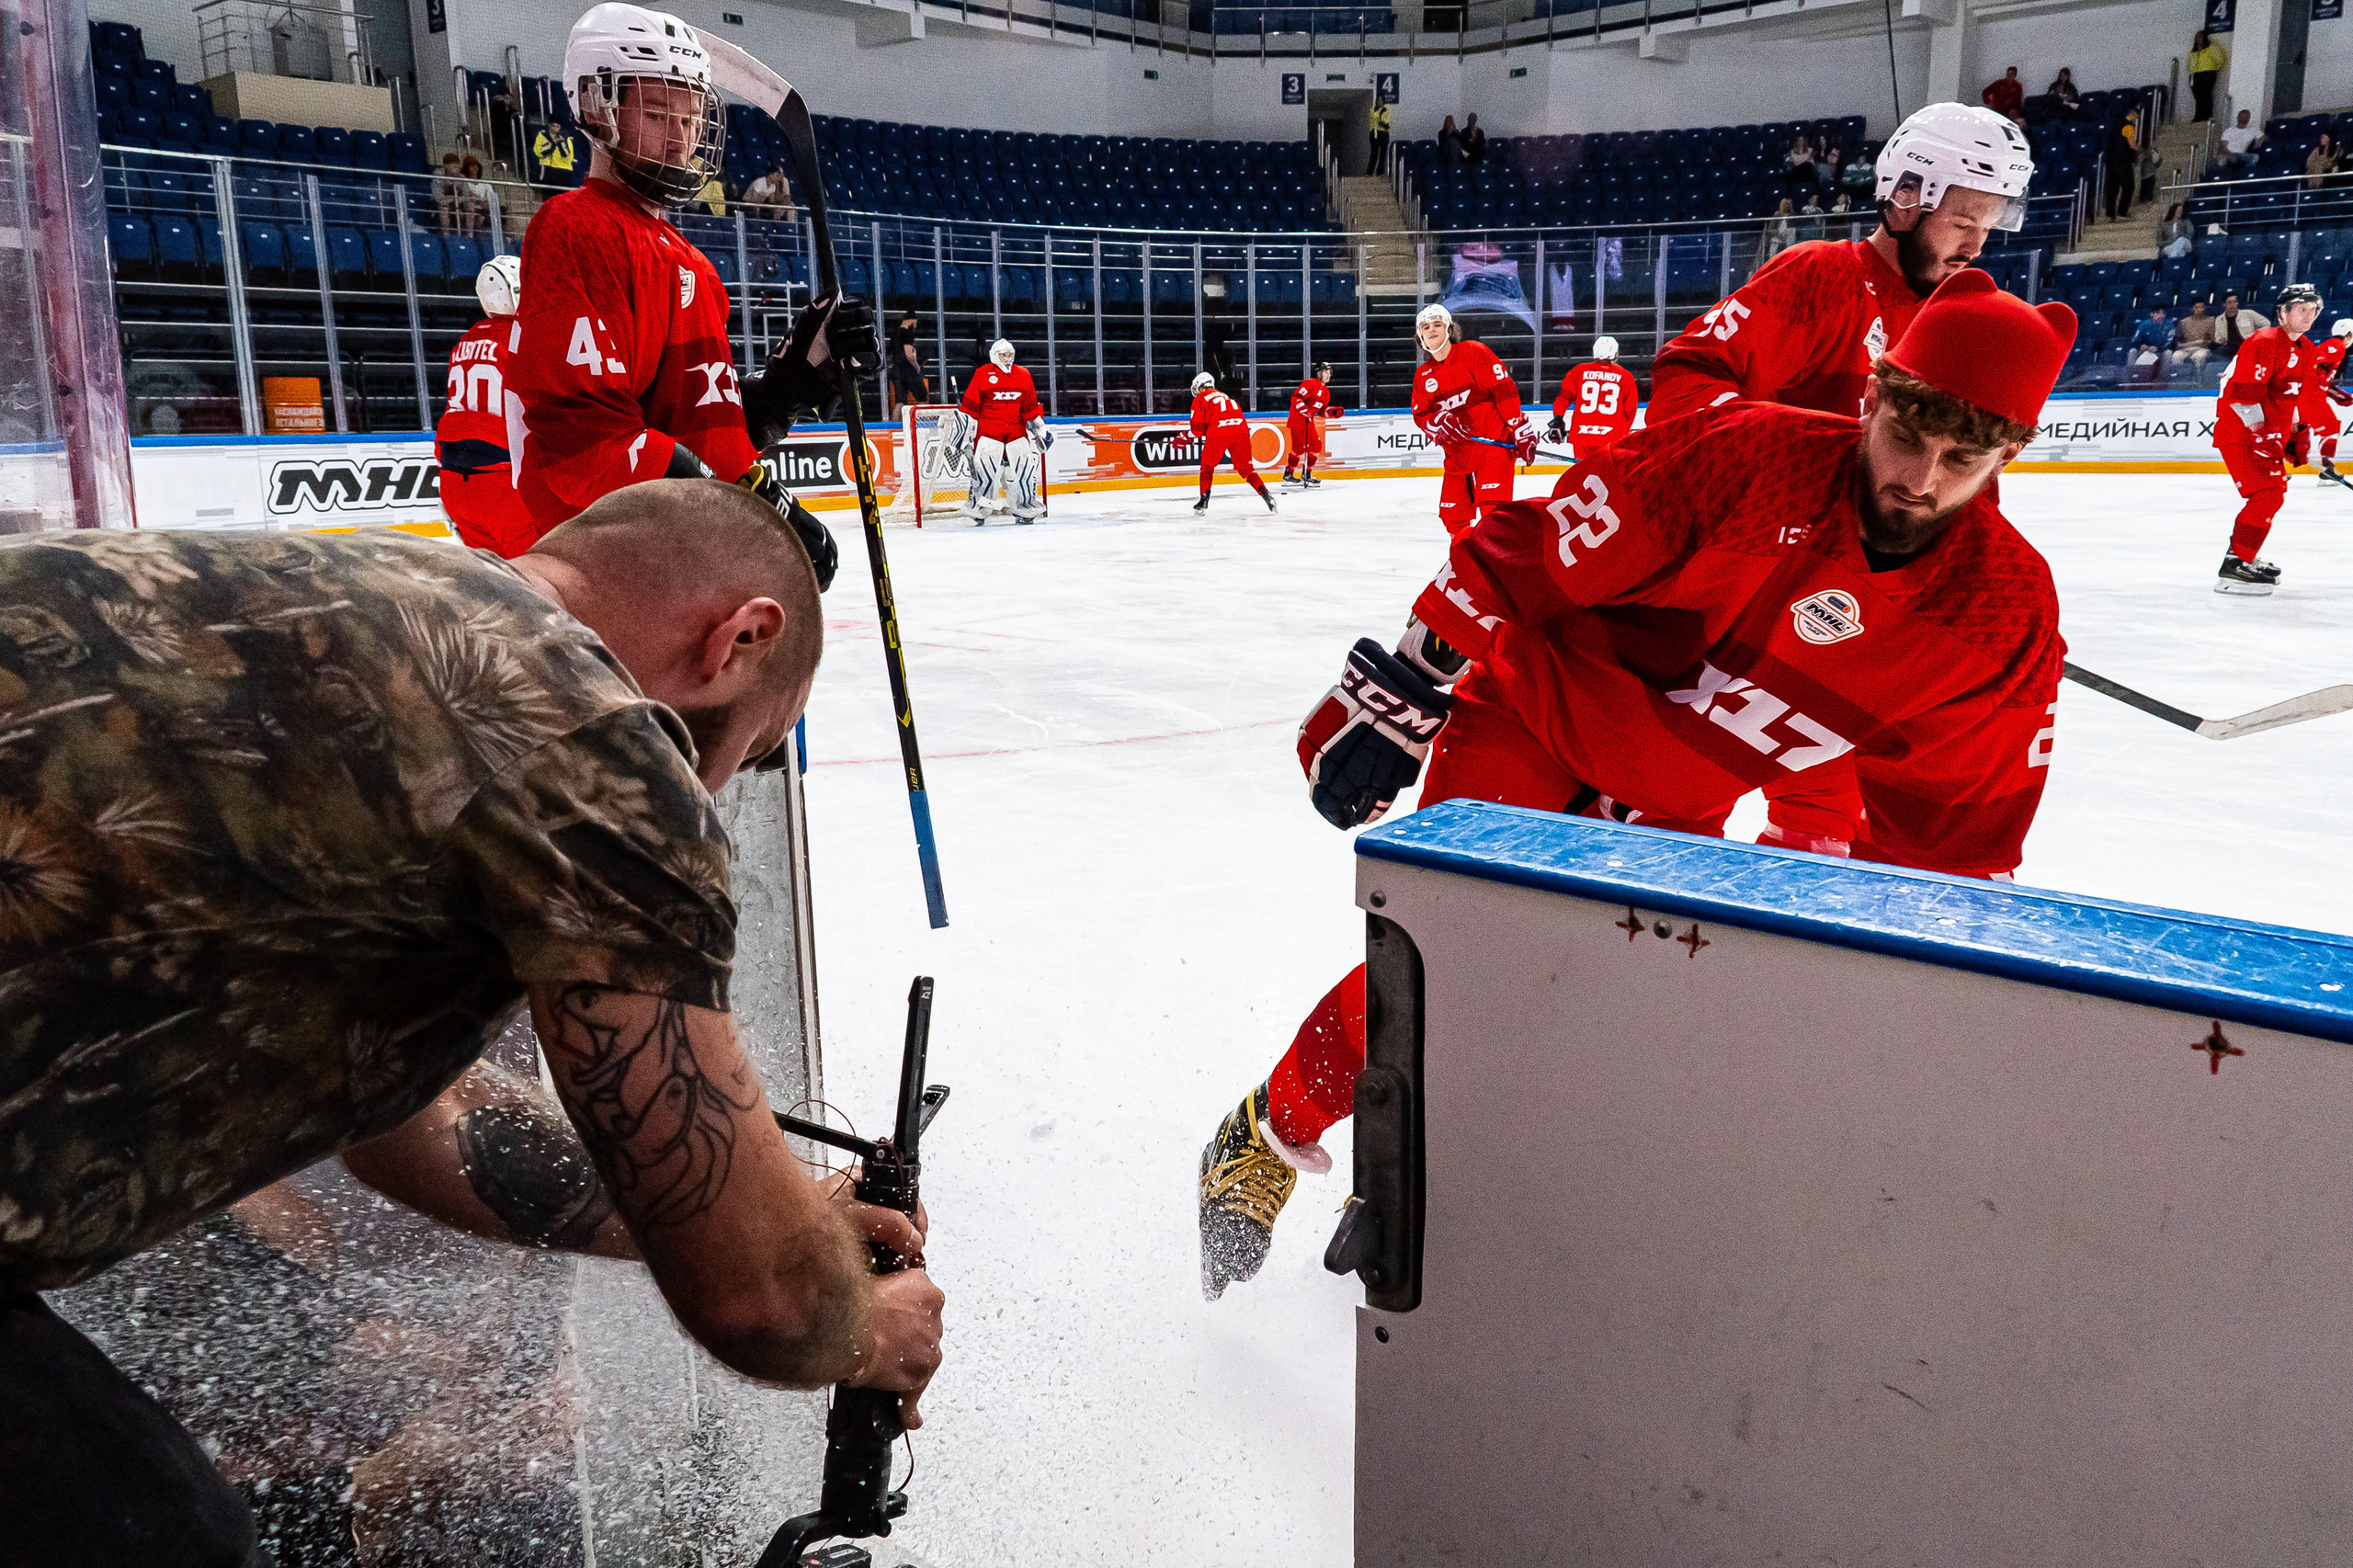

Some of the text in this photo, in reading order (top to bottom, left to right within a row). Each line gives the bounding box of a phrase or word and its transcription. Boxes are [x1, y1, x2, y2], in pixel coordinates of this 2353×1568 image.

[669, 45, 702, 59] CCM
[1288, 76, 1300, 93] 3
[1381, 75, 1393, 93] 4
[1906, 152, 1935, 166] CCM
[993, 392, 1022, 400] X17
[1580, 381, 1620, 415] 93
[1578, 425, 1614, 436] X17
[2038, 418, 2190, 441] МЕДИЙНАЯ
[754, 451, 832, 481] nline
[1546, 474, 1620, 568] 22
[1343, 662, 1442, 735] CCM
[1665, 659, 1856, 773] X17
